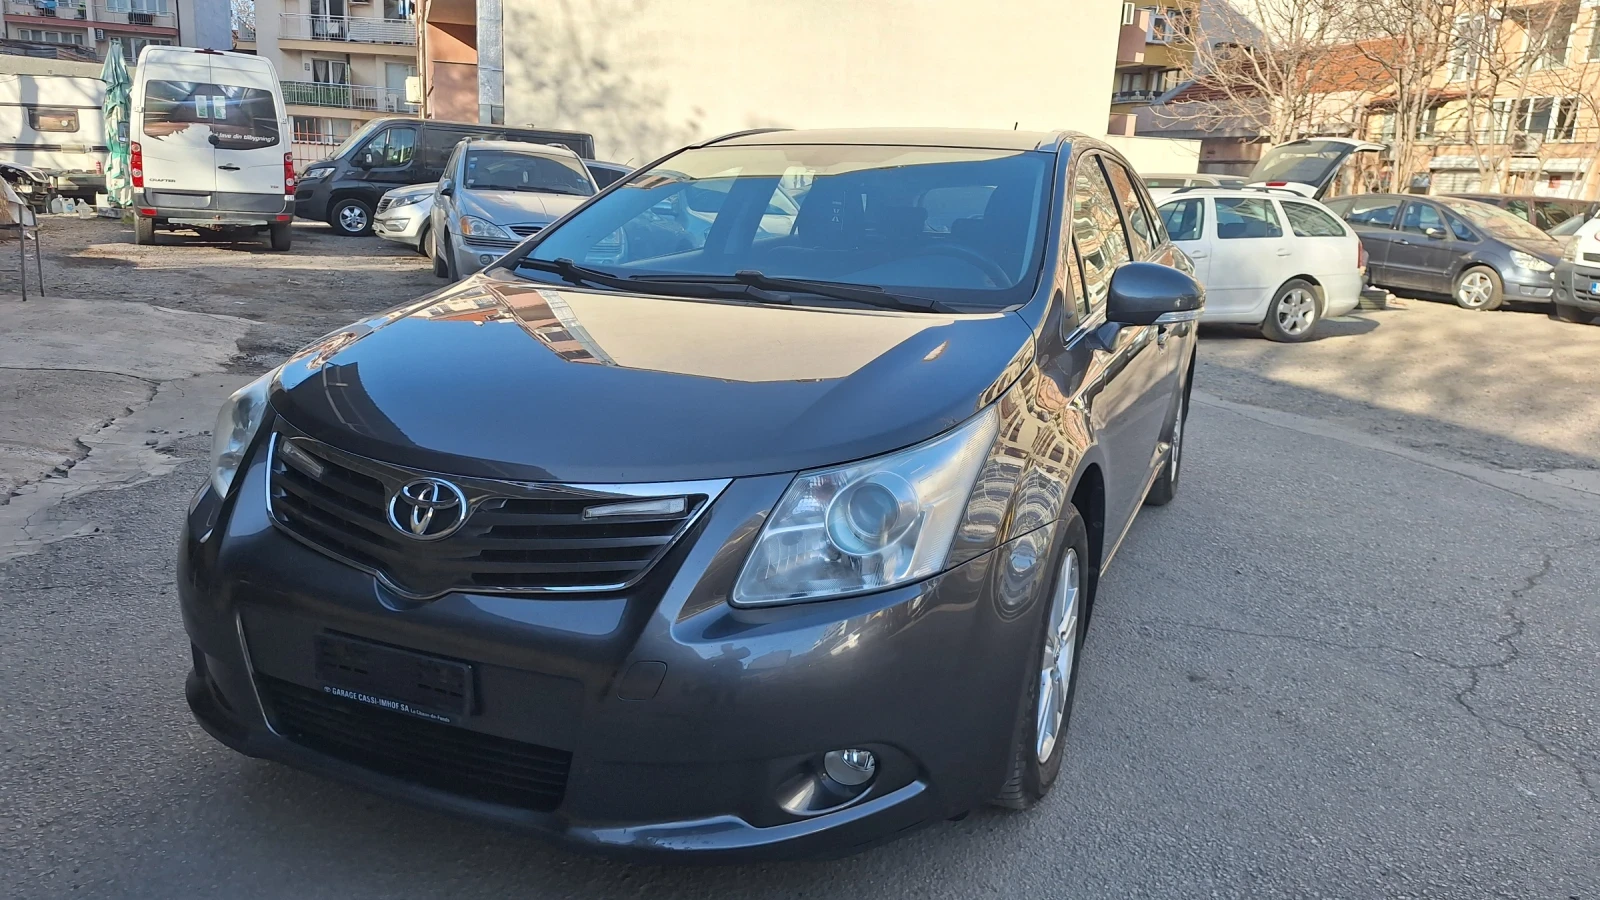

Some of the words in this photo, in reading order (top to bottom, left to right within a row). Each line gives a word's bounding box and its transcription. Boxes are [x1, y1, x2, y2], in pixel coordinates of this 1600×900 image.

[332, 687, 357, 700] GARAGE
[358, 693, 400, 710] CASSI-IMHOF
[400, 703, 410, 712] SA
